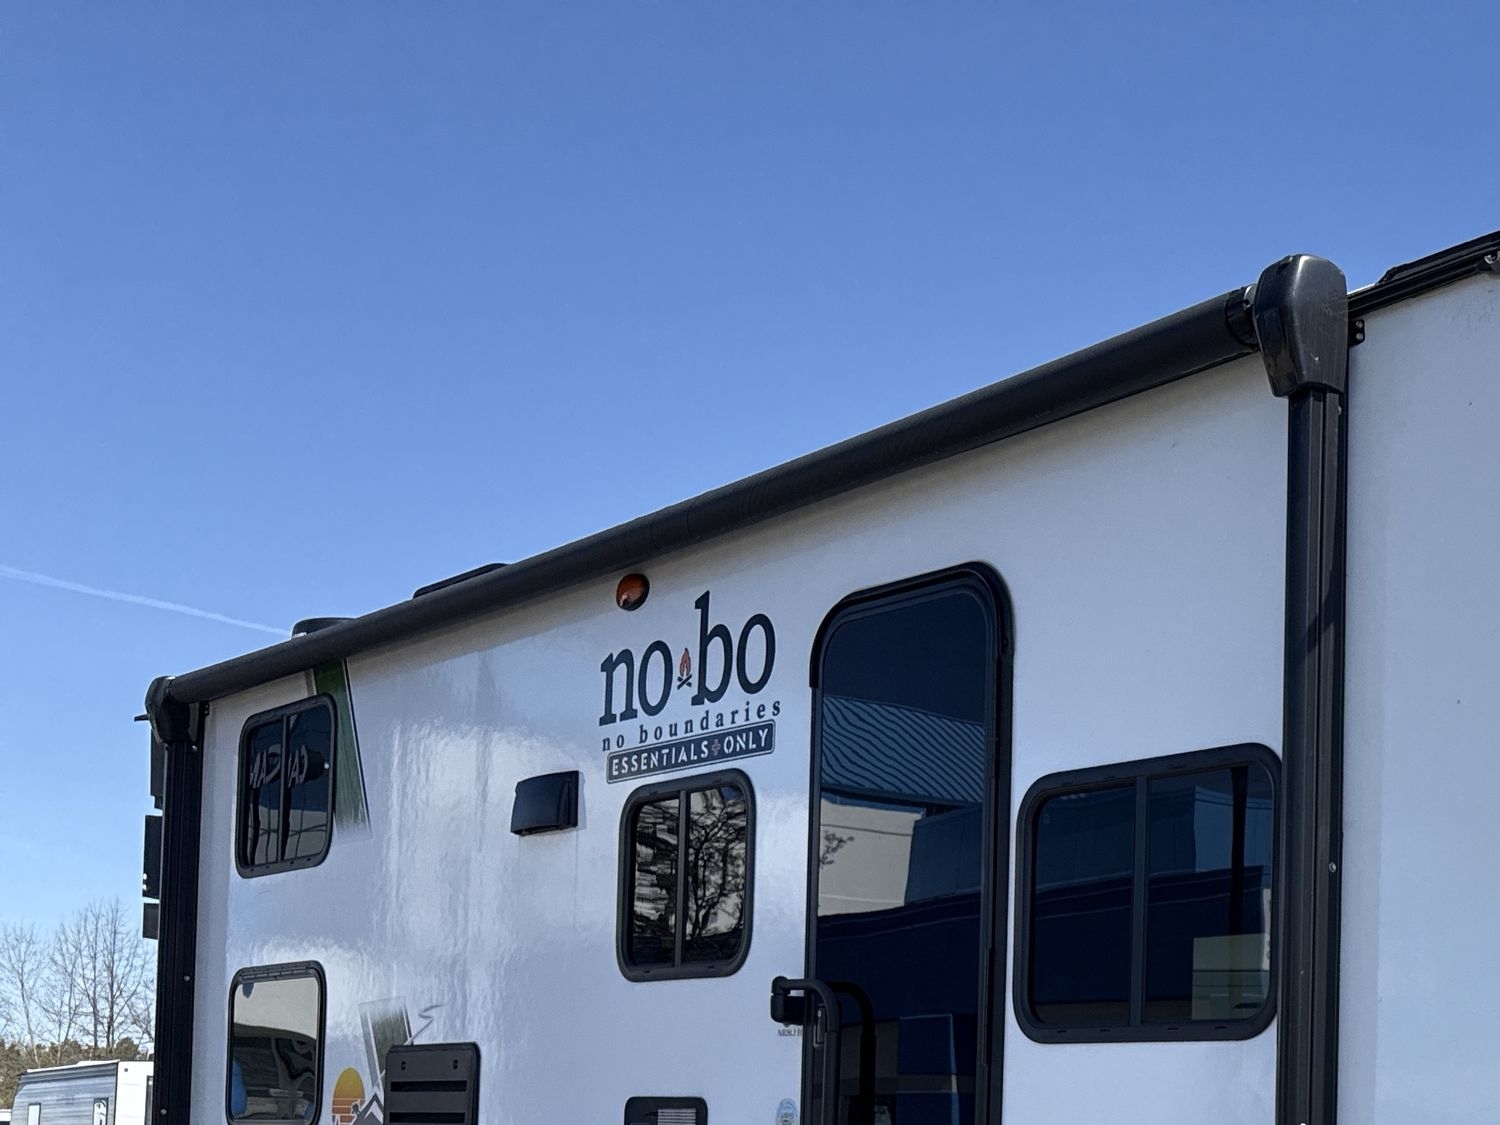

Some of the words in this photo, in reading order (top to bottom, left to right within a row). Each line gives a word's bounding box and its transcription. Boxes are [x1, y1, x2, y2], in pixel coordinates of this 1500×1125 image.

[602, 734, 625, 752] no
[638, 700, 781, 744] boundaries
[611, 740, 709, 776] ESSENTIALS
[723, 728, 770, 754] ONLY
